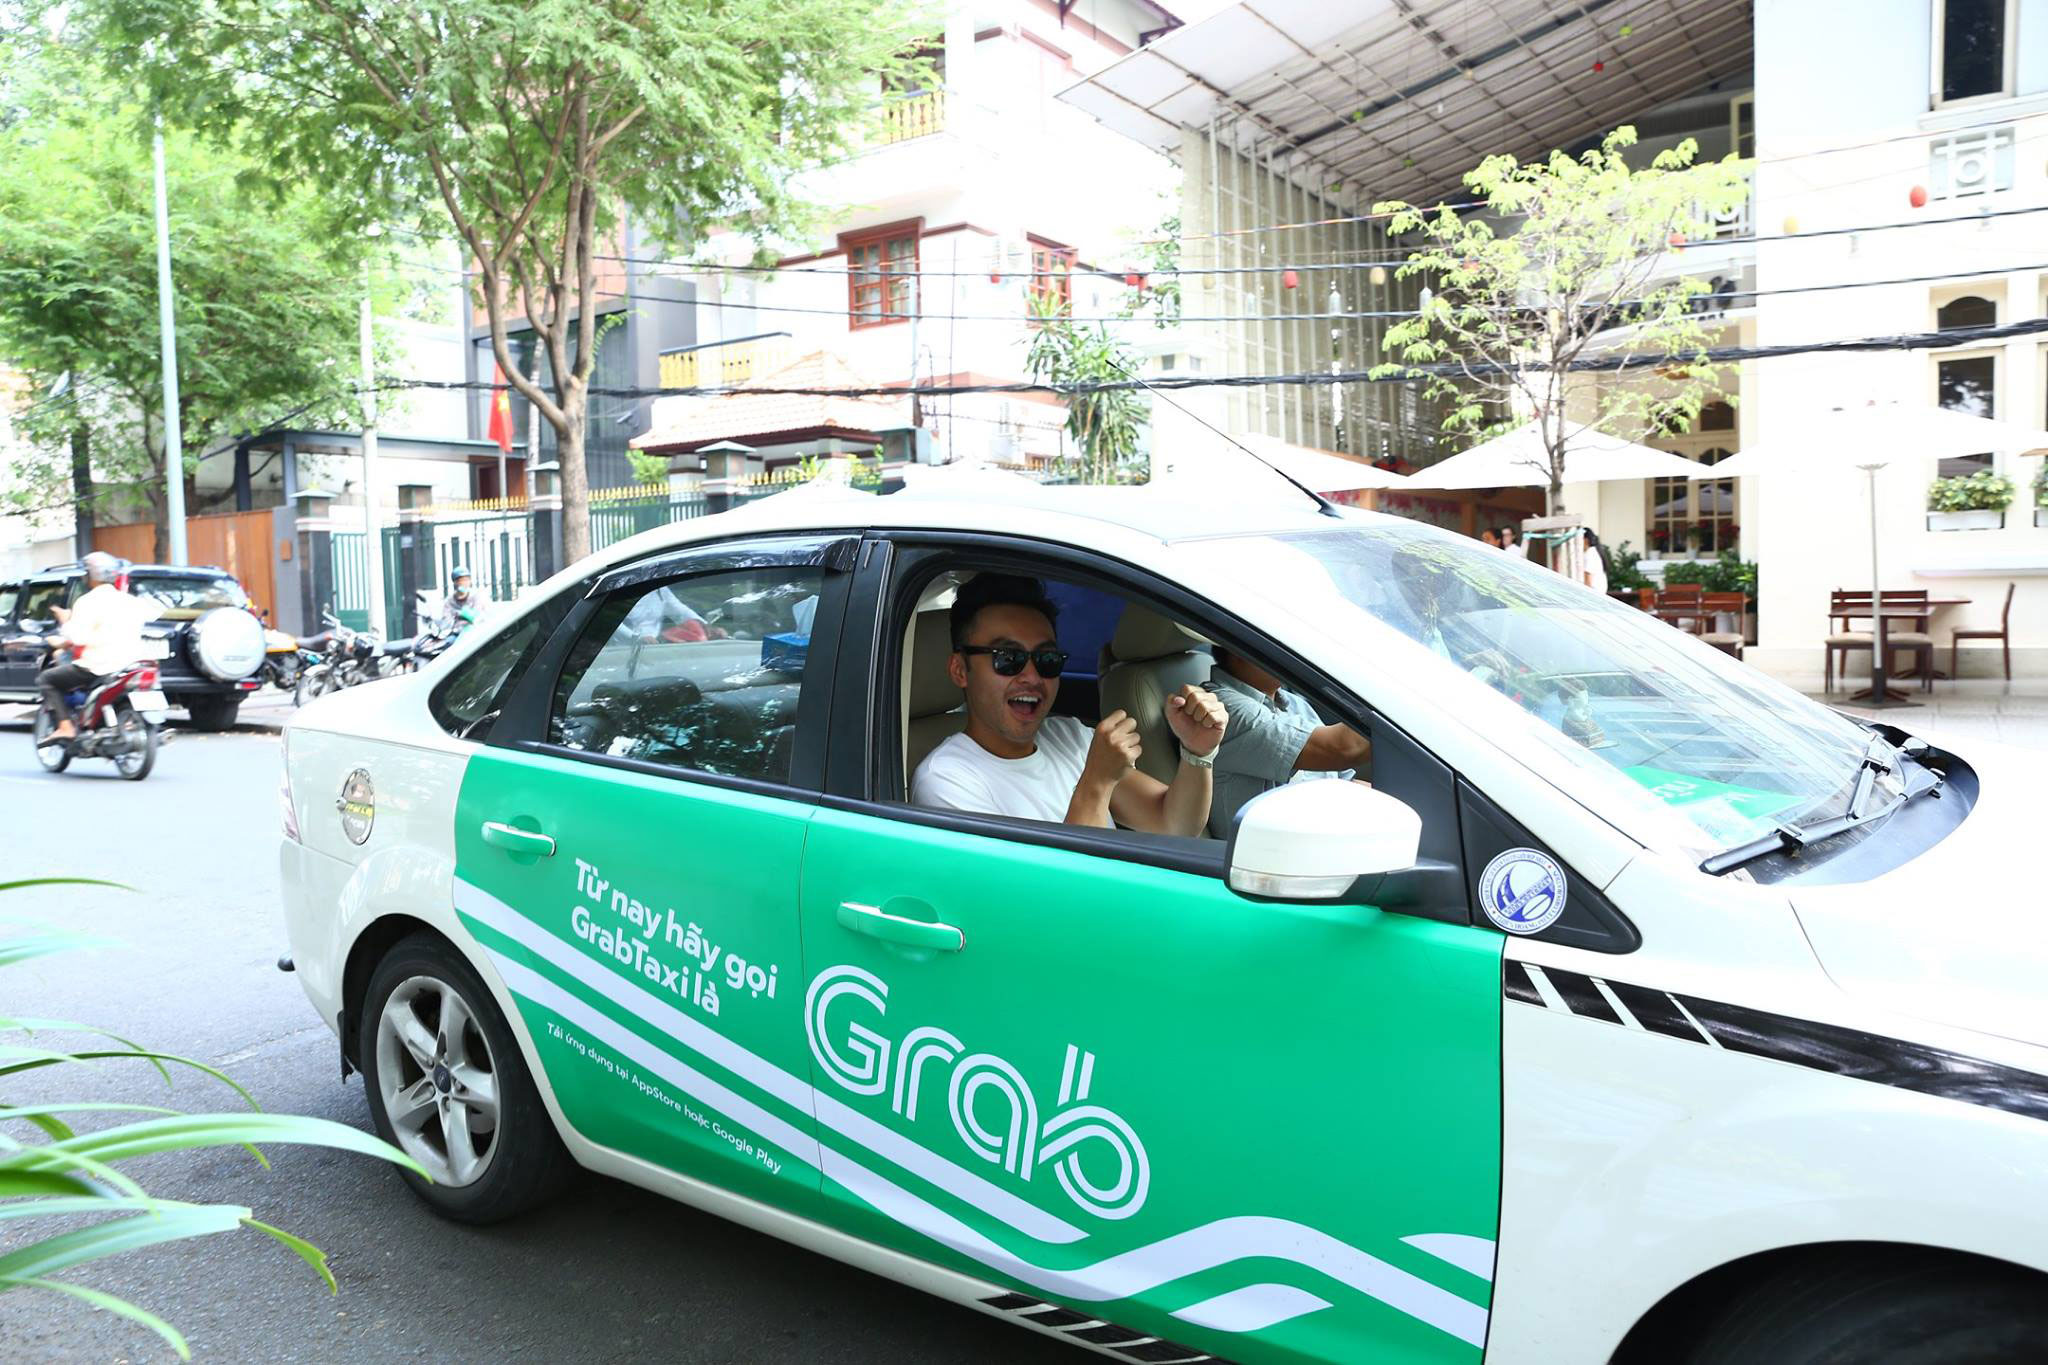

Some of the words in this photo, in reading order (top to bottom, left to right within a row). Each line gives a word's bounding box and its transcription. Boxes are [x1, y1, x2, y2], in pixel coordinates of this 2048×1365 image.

[571, 905, 689, 998] GrabTaxi
[693, 972, 720, 1016] là
[575, 858, 610, 902] Từ
[610, 888, 662, 939] nay
[665, 908, 721, 972] hãy
[725, 953, 778, 999] gọi
[547, 1022, 564, 1039] Tải
[588, 1048, 614, 1073] dụng
[615, 1064, 629, 1080] tại
[631, 1074, 682, 1111] AppStore
[684, 1105, 710, 1129] hoặc
[712, 1122, 753, 1155] Google
[756, 1148, 782, 1175] Play
[804, 964, 1150, 1220] Grab
